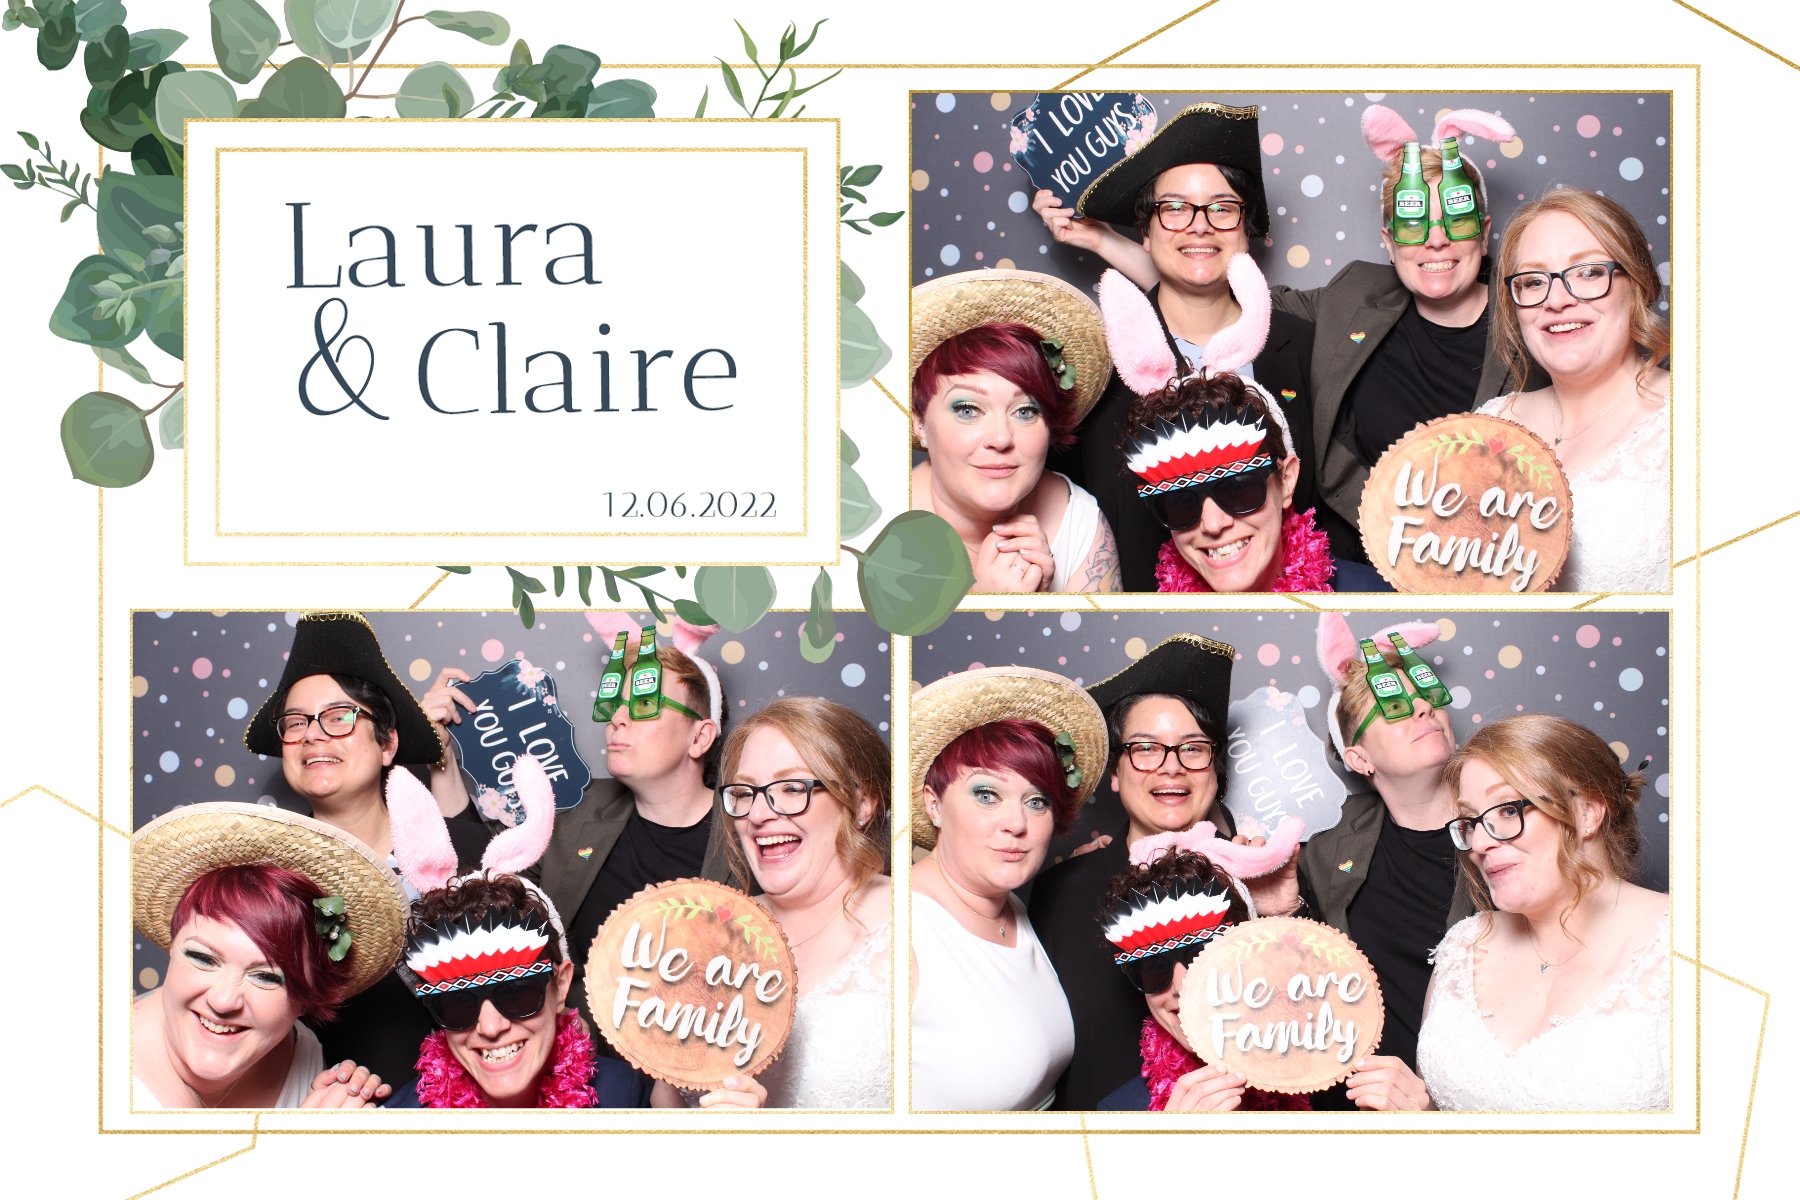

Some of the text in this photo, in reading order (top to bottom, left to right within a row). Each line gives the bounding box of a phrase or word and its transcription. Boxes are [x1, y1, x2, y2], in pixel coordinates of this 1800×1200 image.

[1033, 128, 1054, 154] I
[1051, 102, 1136, 193] YOU GUYS
[1448, 195, 1470, 204] BEER
[1394, 453, 1563, 530] We are
[1388, 515, 1541, 593] Family
[468, 698, 508, 747] YOU
[508, 697, 537, 711] I
[1228, 726, 1262, 774] YOU
[1260, 720, 1325, 809] I LOVE
[621, 917, 788, 1003] We are
[1206, 957, 1369, 1009] We are
[612, 977, 765, 1067] Family
[1208, 1001, 1360, 1063] Family
